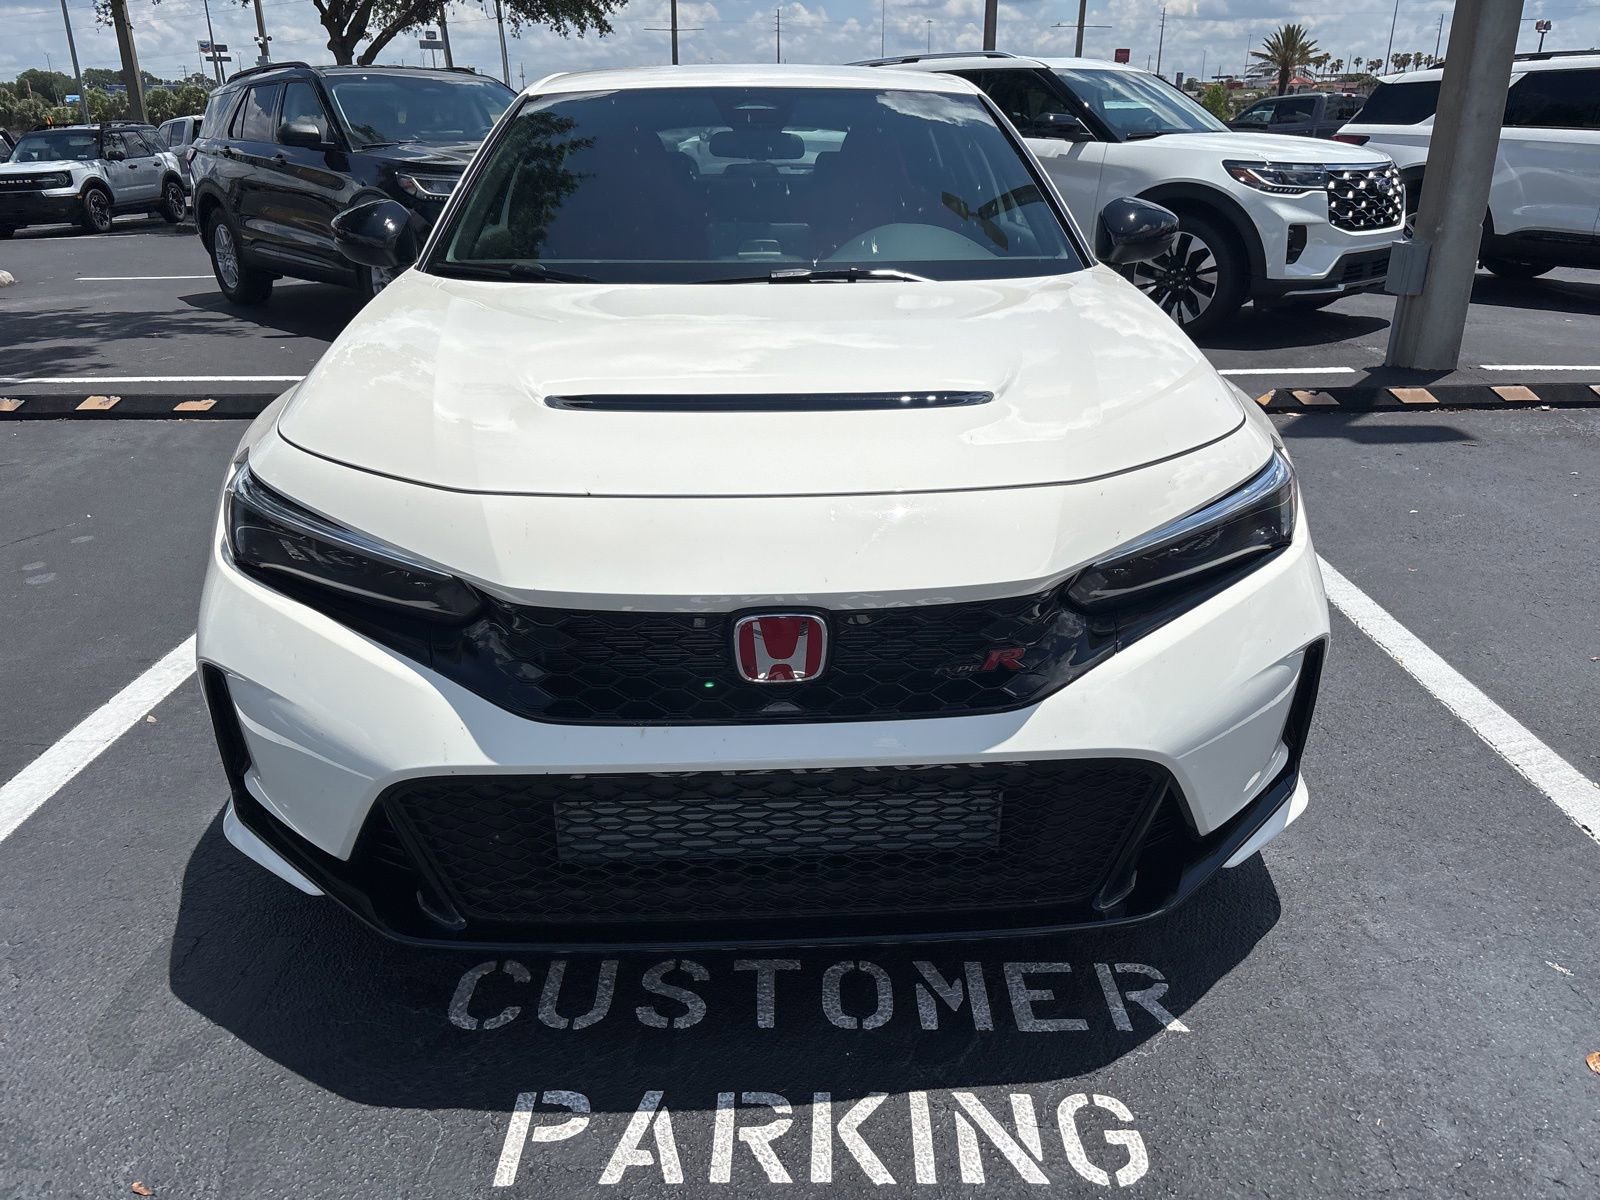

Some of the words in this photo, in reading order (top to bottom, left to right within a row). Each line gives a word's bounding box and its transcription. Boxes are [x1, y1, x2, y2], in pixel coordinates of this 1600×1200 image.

[981, 647, 1027, 672] R
[448, 959, 1190, 1033] CUSTOMER
[493, 1090, 1152, 1188] PARKING
